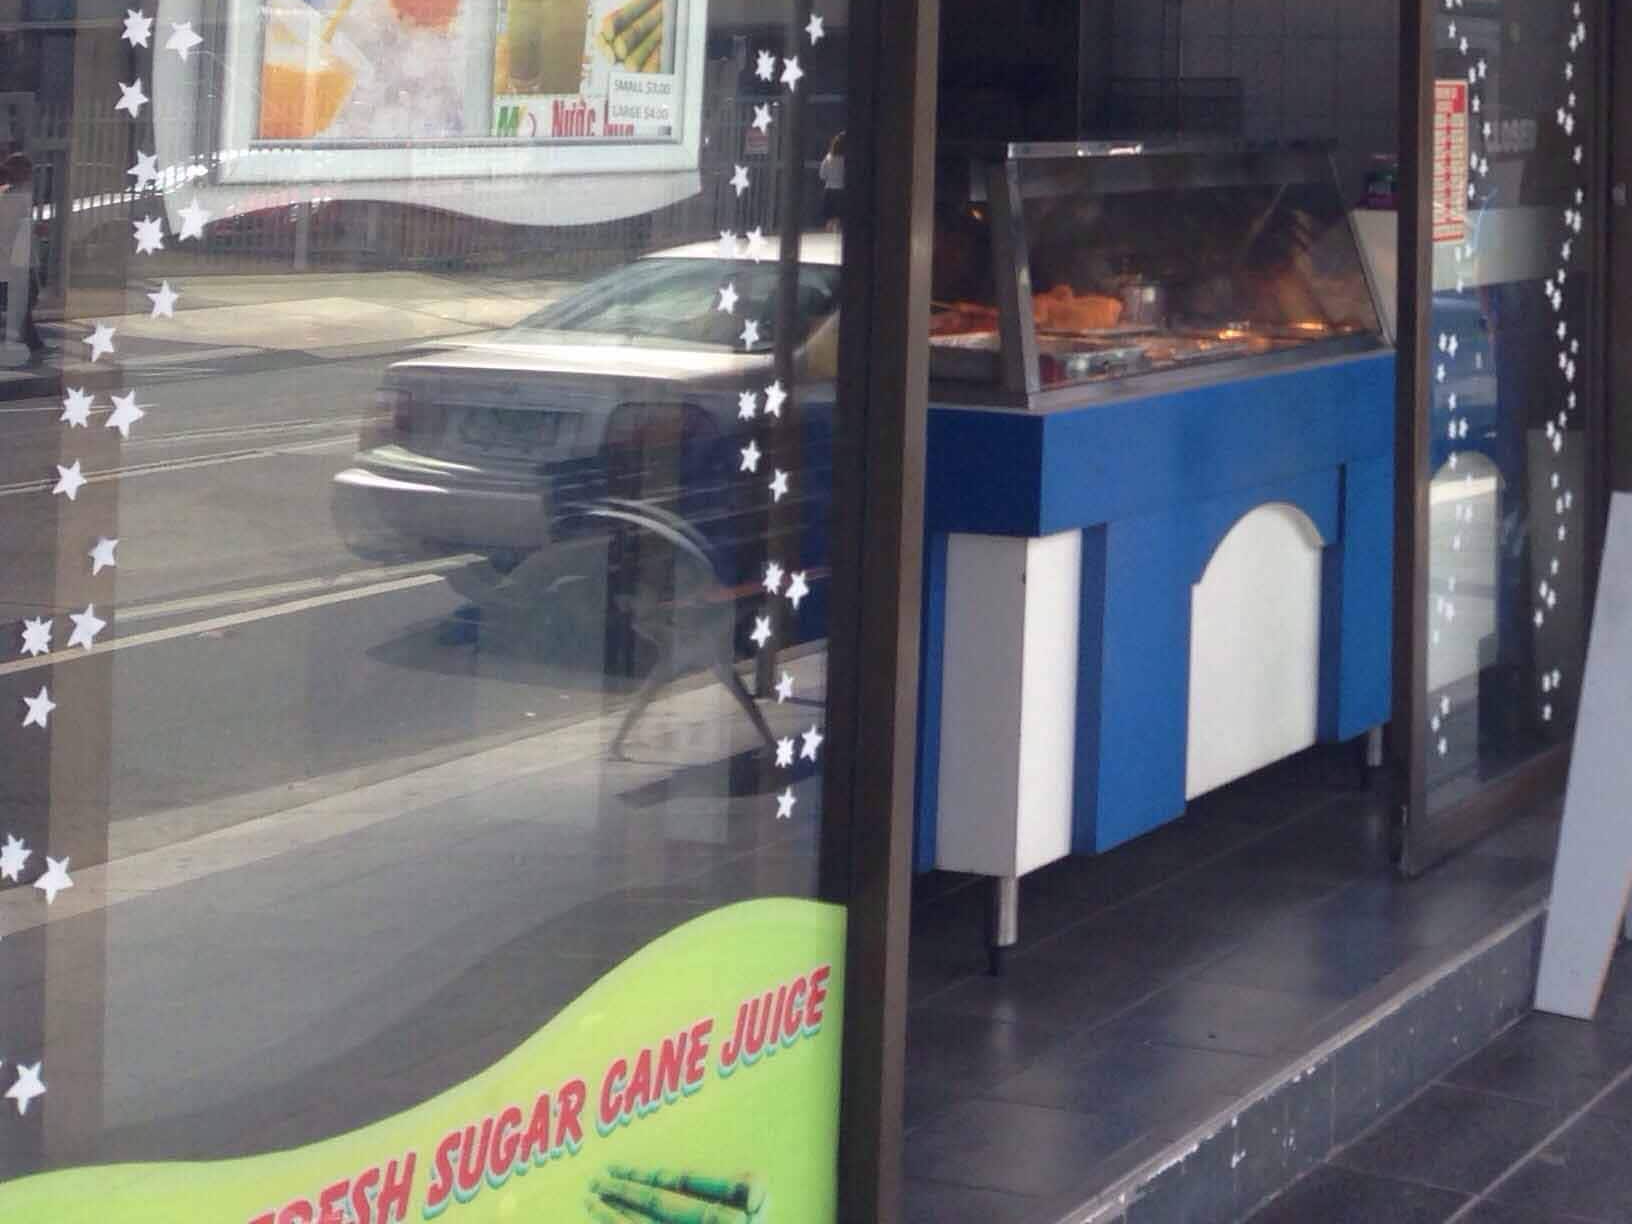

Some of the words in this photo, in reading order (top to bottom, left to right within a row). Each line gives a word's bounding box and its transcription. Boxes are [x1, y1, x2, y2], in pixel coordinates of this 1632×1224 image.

[246, 1151, 418, 1224] ESH
[425, 1078, 586, 1216] SUGAR
[598, 1017, 714, 1136] CANE
[717, 964, 832, 1077] JUICE
